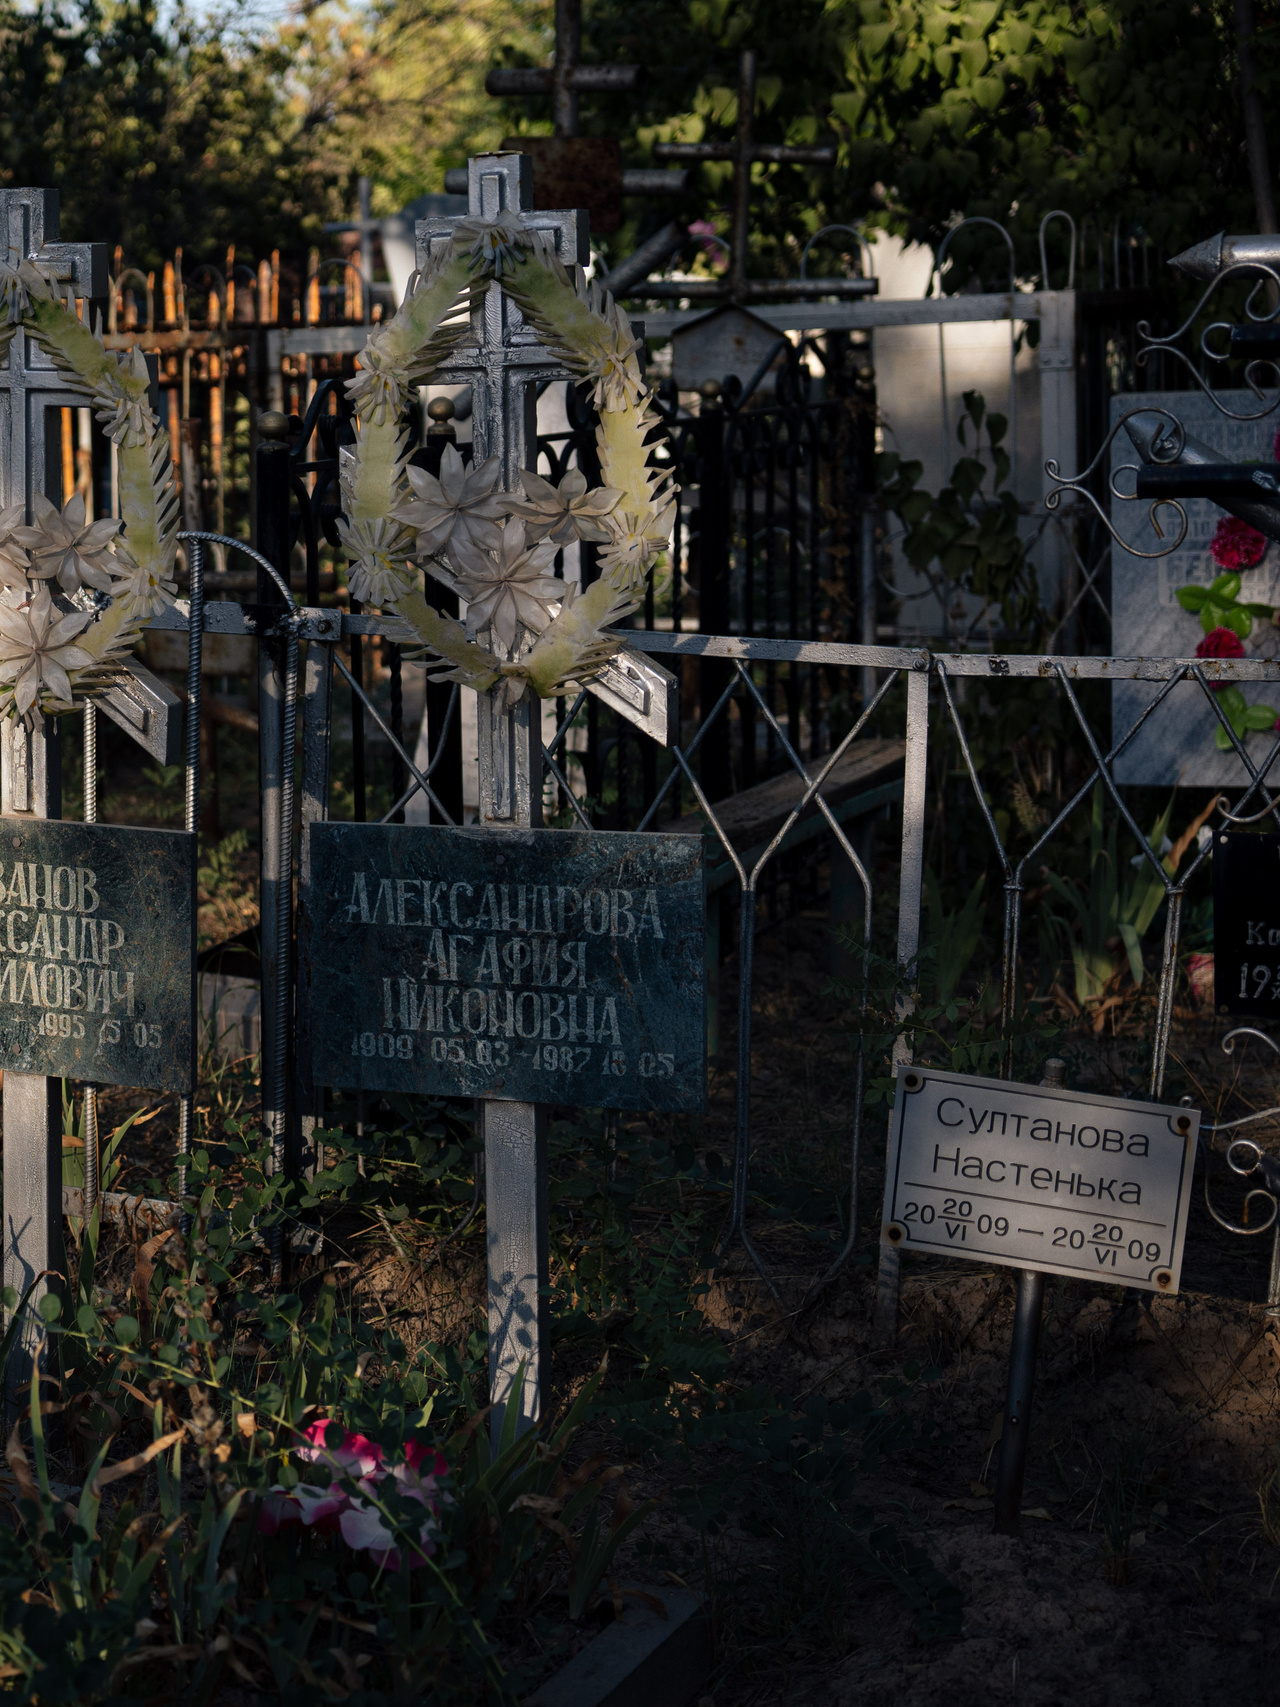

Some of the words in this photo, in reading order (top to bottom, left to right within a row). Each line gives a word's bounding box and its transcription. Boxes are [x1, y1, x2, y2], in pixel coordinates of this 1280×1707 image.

[345, 871, 665, 939] АЛЕКСАНДРОВА
[421, 929, 588, 988] АГАФИЯ
[37, 1012, 86, 1039] 1995
[134, 1023, 163, 1049] 05
[382, 977, 623, 1046] НИКОНОВНА
[532, 1044, 592, 1073] 1987
[937, 1098, 1150, 1157] Султанова
[933, 1144, 1143, 1205] Настенька
